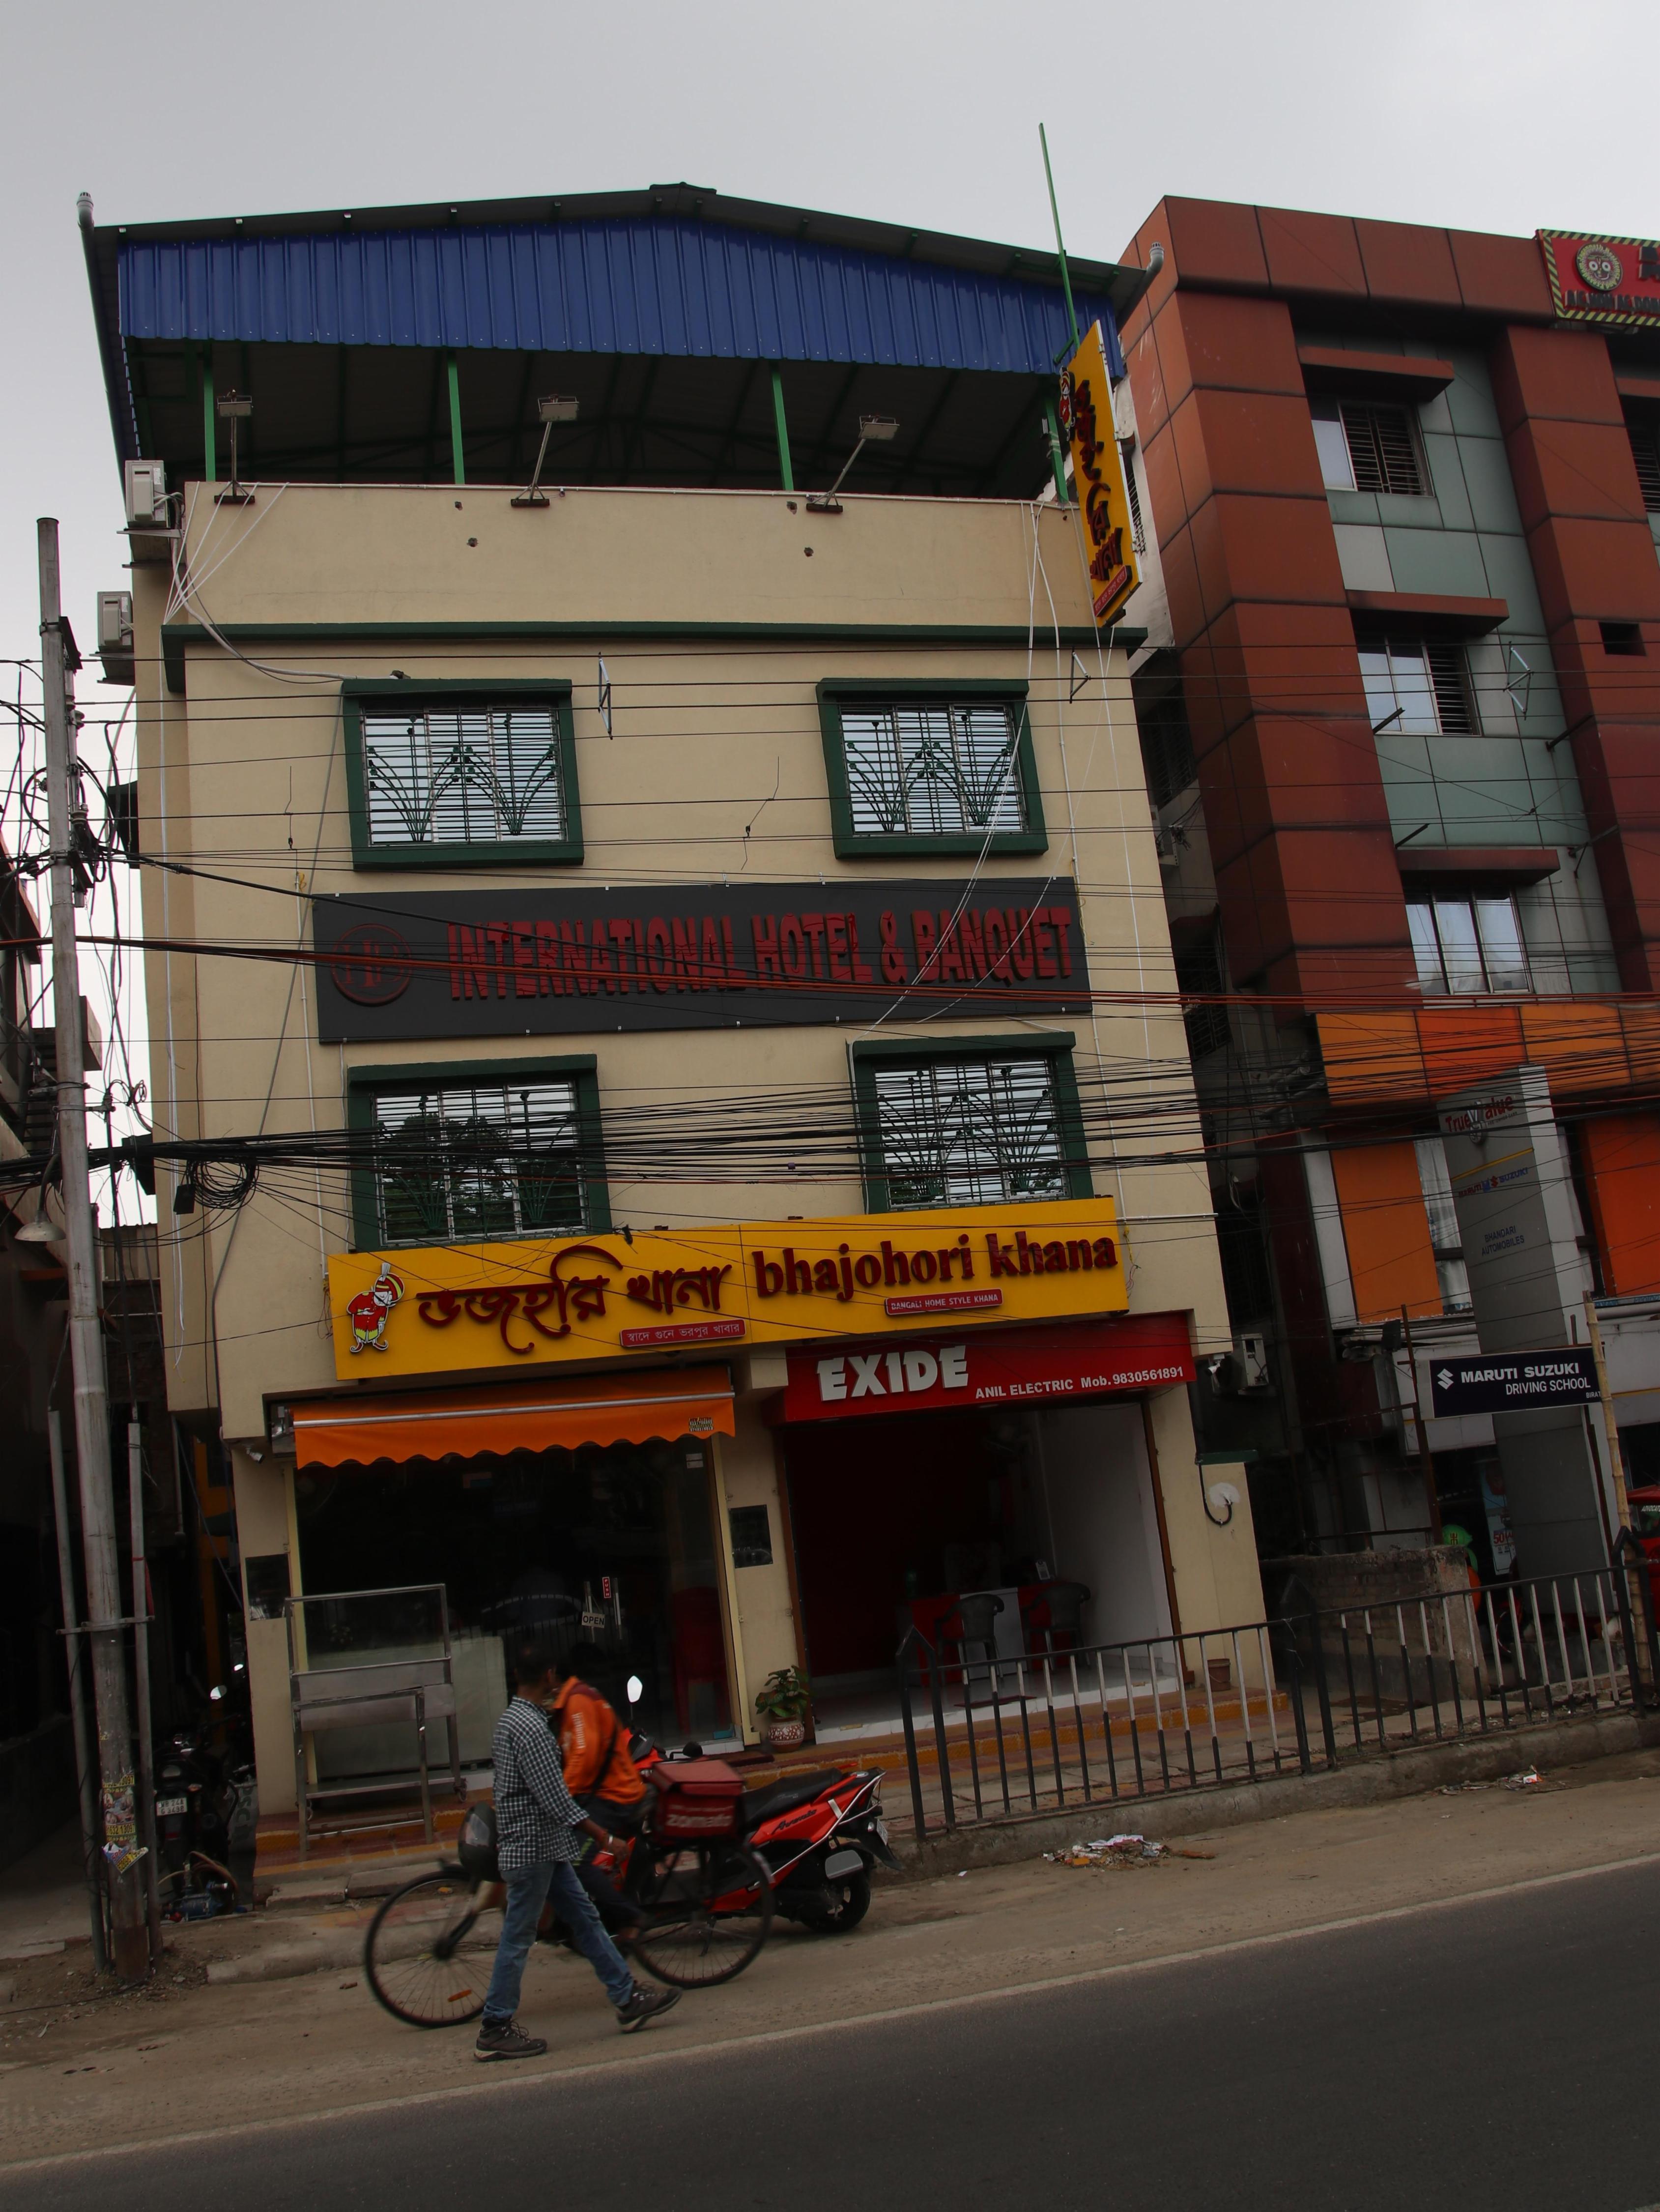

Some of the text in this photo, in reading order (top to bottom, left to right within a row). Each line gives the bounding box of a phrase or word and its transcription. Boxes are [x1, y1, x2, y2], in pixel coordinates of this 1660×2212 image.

[447, 906, 1070, 1000] INTERNATIONAL HOTEL & BANQUET
[1499, 1167, 1528, 1183] SUZUKI
[1485, 1226, 1516, 1243] BHANDARI
[1482, 1235, 1524, 1256] AUTOMOBILES
[752, 1231, 1118, 1302] bhajohori khana
[627, 1265, 732, 1314] খানা
[925, 1298, 946, 1308] HOME
[948, 1295, 972, 1306] STYLE
[973, 1293, 999, 1304] KHANA
[679, 1326, 708, 1338] ভরপুর
[713, 1323, 740, 1334] খাবার
[816, 1345, 969, 1401] EXIDE
[975, 1367, 1184, 1400] ANIL ELECTRIC Mob. 9830561891
[1461, 1363, 1579, 1384] MARUTI SUZUKI
[1506, 1377, 1591, 1396] DRIVING SCHOOL
[583, 1615, 604, 1625] OPEN
